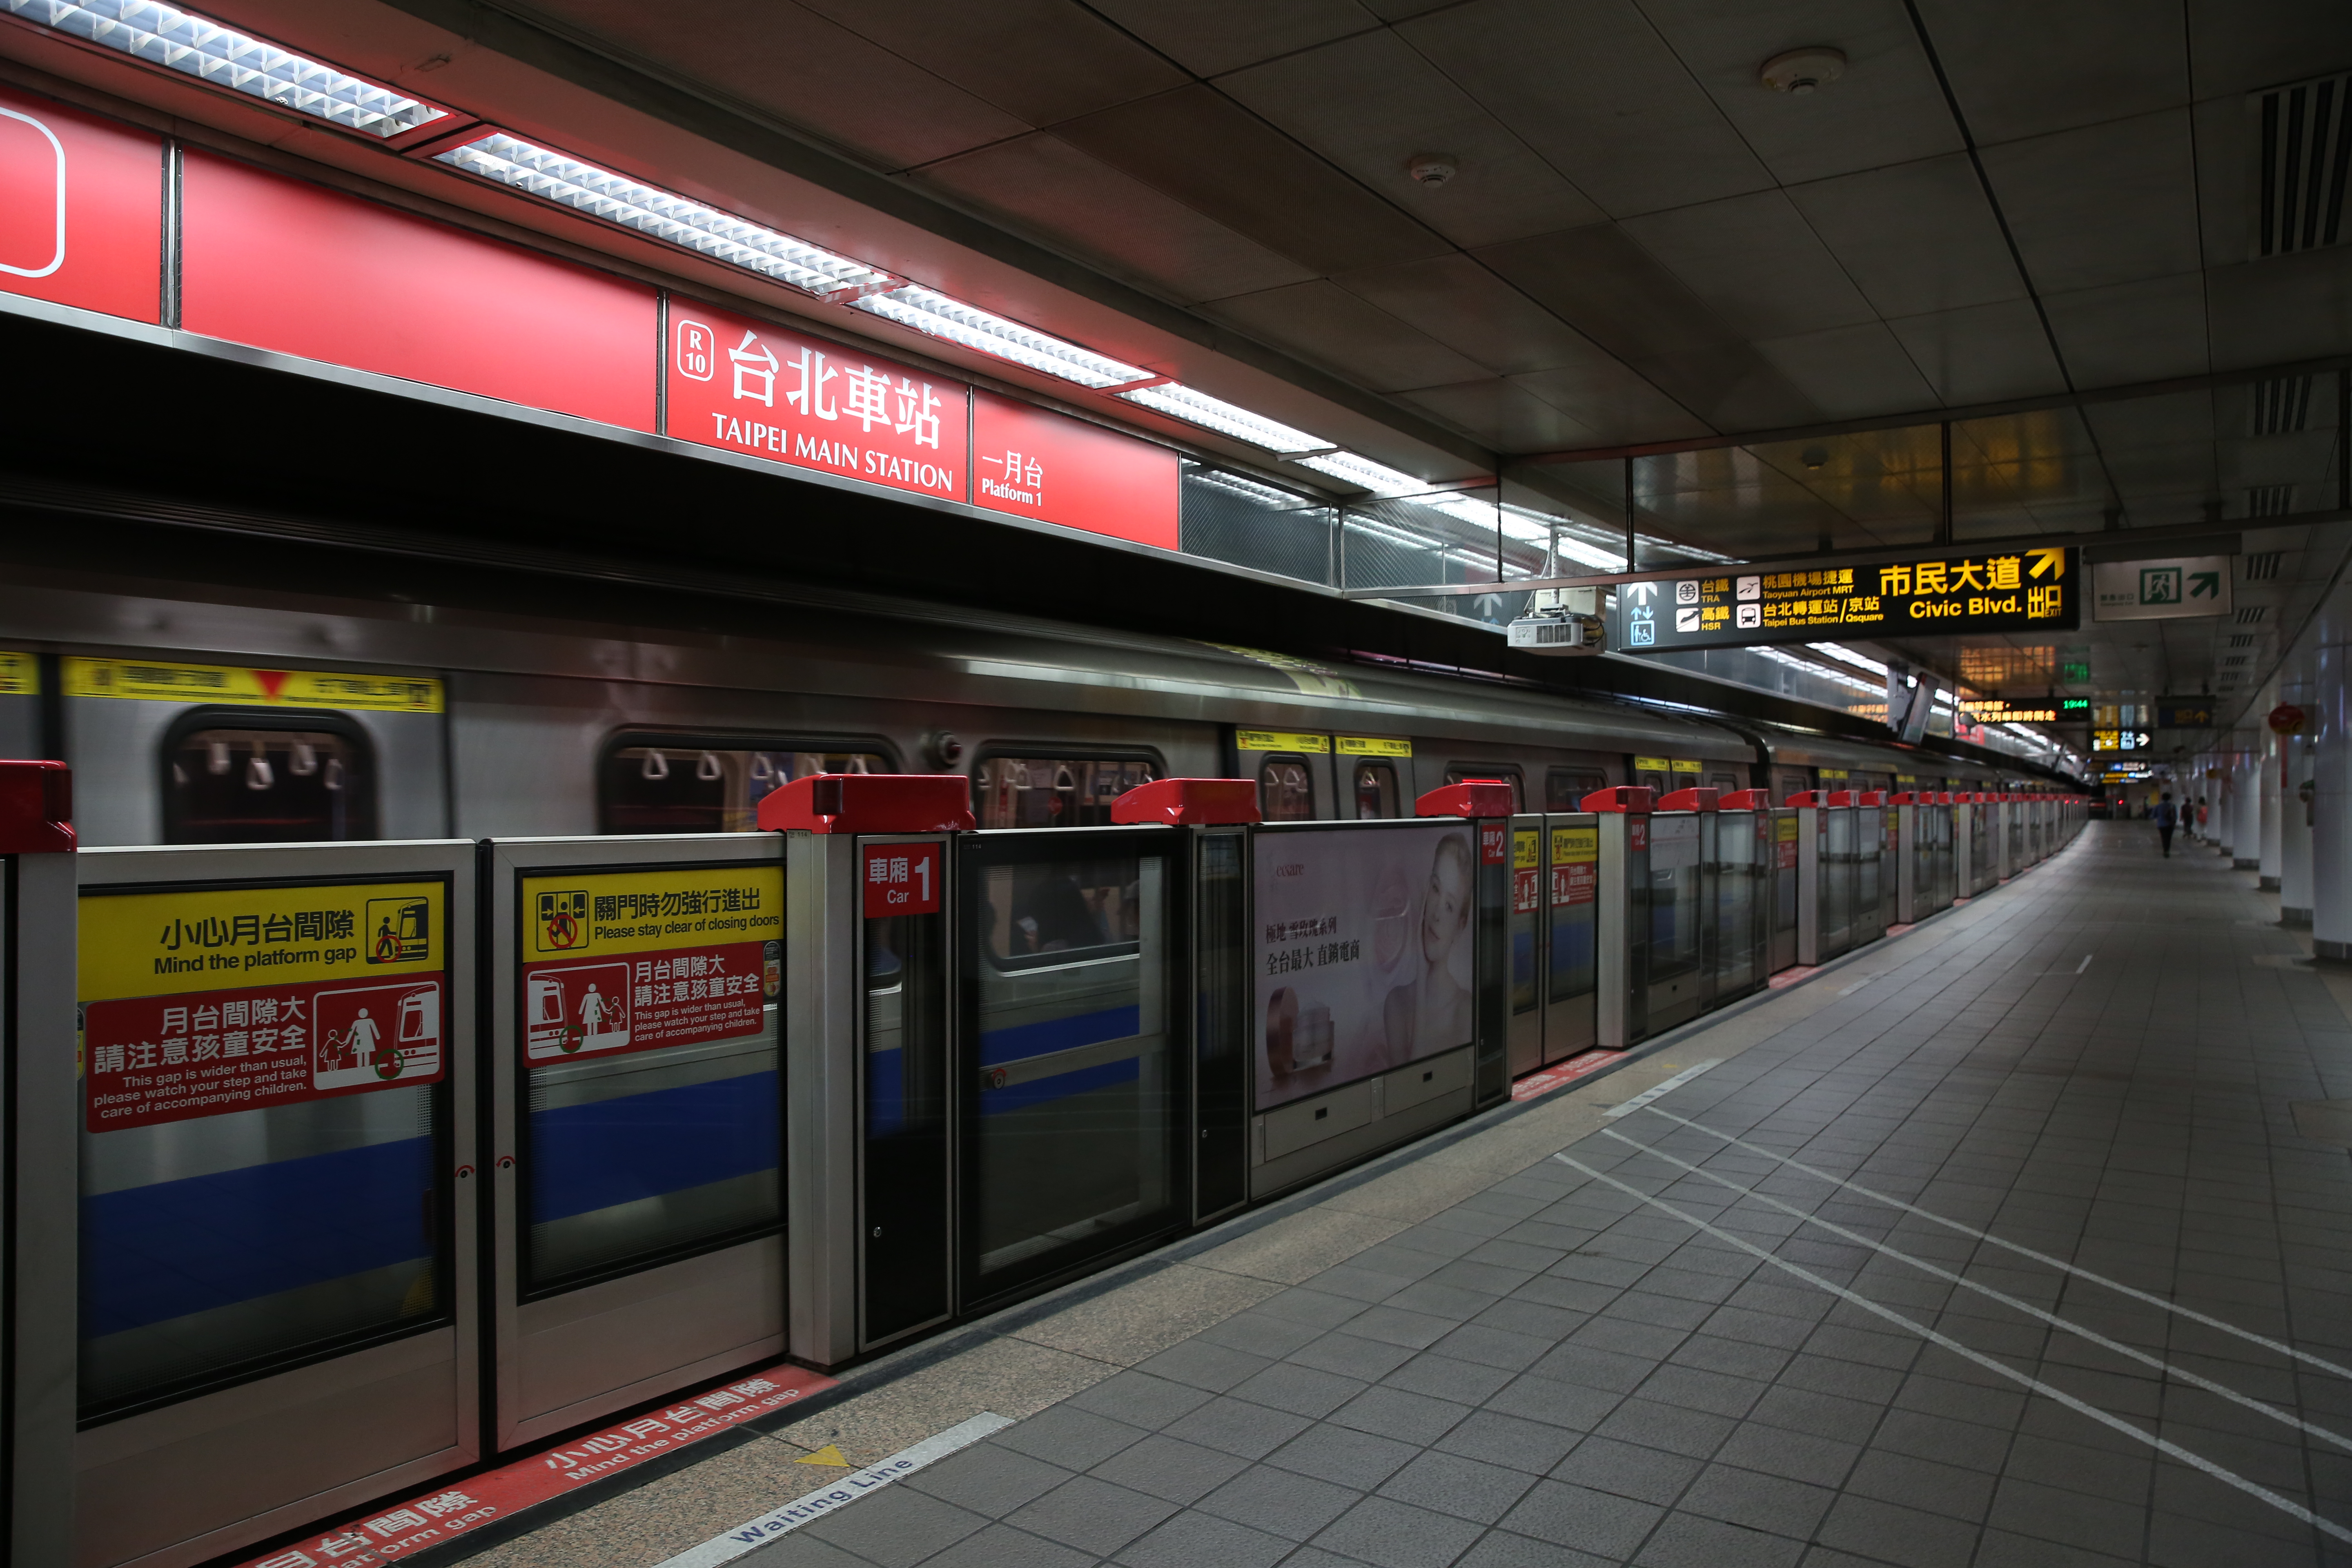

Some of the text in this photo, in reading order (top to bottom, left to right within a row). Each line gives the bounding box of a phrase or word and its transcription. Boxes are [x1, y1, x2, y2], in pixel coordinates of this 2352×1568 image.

[690, 330, 703, 351] R
[686, 352, 706, 373] 10
[728, 330, 942, 449] 台北車站
[712, 412, 952, 492] TAIPEI MAIN STATION
[982, 450, 1044, 489] 一月台
[982, 477, 1042, 507] Platform 1
[1702, 578, 1729, 593] 台鐵
[1763, 568, 1853, 588] 桃園機場捷運
[1879, 556, 2022, 597] 市民大道
[1702, 595, 1720, 603] TRA
[1762, 585, 1854, 601] Taoyuan Airport MRT
[1909, 595, 2022, 619] Civic Blvd.
[2027, 585, 2062, 620] 出口
[1701, 605, 1730, 621] 高鐵
[1701, 622, 1722, 631] HSR
[1762, 613, 1884, 628] Taipei Bus Station Qsquare
[2045, 608, 2062, 617] EXIT
[2063, 699, 2088, 709] 19:44
[1496, 831, 1503, 857] 2
[869, 856, 929, 901] 車廂 1
[595, 887, 760, 922] 關門時勿強行進出
[887, 889, 910, 904] Car
[160, 909, 355, 950] 小心月台間隙
[595, 915, 780, 940] Please stay clear of closing doors
[154, 947, 357, 974] Mind the platform gap
[635, 954, 726, 983] 月台間隙大
[1266, 939, 1360, 976] 全台最大 直銷電商
[635, 973, 760, 1007] 請注意孩童安全
[160, 996, 307, 1035] 月台間隙大
[635, 1011, 653, 1020] This
[655, 1011, 670, 1020] gap
[681, 1005, 703, 1014] wider
[705, 1002, 722, 1011] than
[723, 999, 746, 1009] usual,
[635, 1007, 760, 1033] please watch your step and take
[635, 1033, 654, 1042] care
[666, 1023, 723, 1037] accompanying
[725, 1018, 757, 1028] children.
[94, 1024, 307, 1074] 請注意孩童安全
[122, 1055, 307, 1088] This gap is wider than usual,
[94, 1069, 307, 1108] please watch your step and take
[101, 1081, 307, 1119] care of accompanying children.
[544, 1378, 780, 1469] 小心月台間隙
[565, 1387, 800, 1480] Mind the platform gap
[730, 1459, 913, 1544] Waiting Line
[444, 1505, 497, 1530] gap
